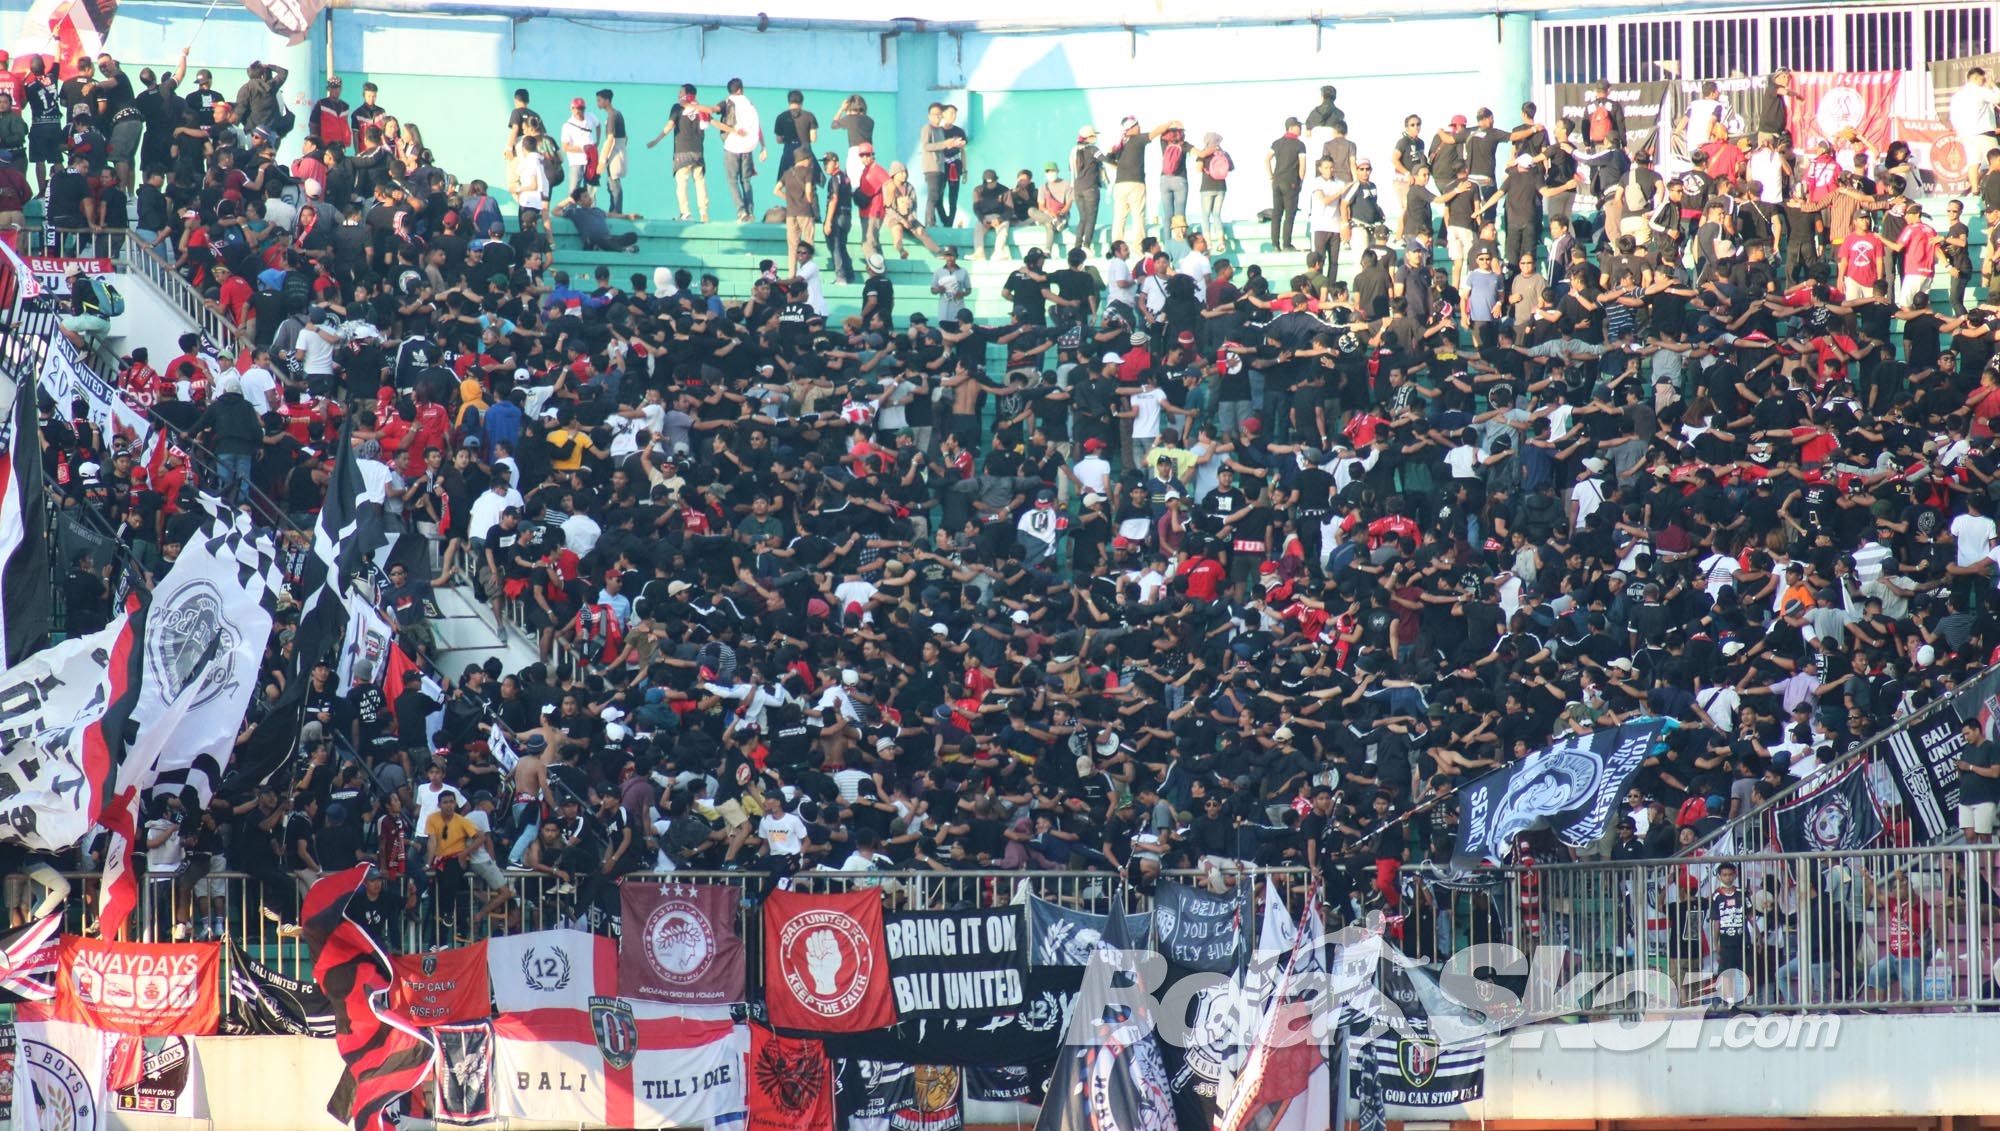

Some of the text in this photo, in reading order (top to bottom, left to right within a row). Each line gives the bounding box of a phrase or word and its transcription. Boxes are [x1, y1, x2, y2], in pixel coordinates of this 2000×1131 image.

[1715, 79, 1751, 91] NITED
[56, 333, 73, 363] BALI
[1920, 722, 1952, 748] BALI
[1928, 733, 1968, 763] UNITE
[782, 914, 865, 945] BALI UNITED FC
[885, 915, 1017, 960] BRING IT ON
[1215, 922, 1233, 937] CA
[74, 949, 198, 975] AWAYDAYS
[1175, 945, 1202, 962] FLY
[249, 961, 313, 994] BALI UNITED FC
[534, 958, 559, 979] 12
[427, 981, 455, 992] CALM
[788, 973, 867, 1014] KEEP THE FAITH
[943, 968, 1024, 1010] UNITED
[409, 1005, 430, 1017] RISE
[432, 1008, 444, 1017] UP
[1372, 1014, 1406, 1029] AWAY
[157, 1049, 181, 1066] BOYS
[42, 1051, 84, 1093] BOYS
[517, 1071, 588, 1092] BALI
[642, 1081, 687, 1100] TILL
[703, 1065, 732, 1090] DIE
[984, 1088, 1011, 1098] NEVER
[1385, 1089, 1406, 1103] GOD
[1408, 1091, 1431, 1104] CAN
[1432, 1089, 1459, 1104] STOP
